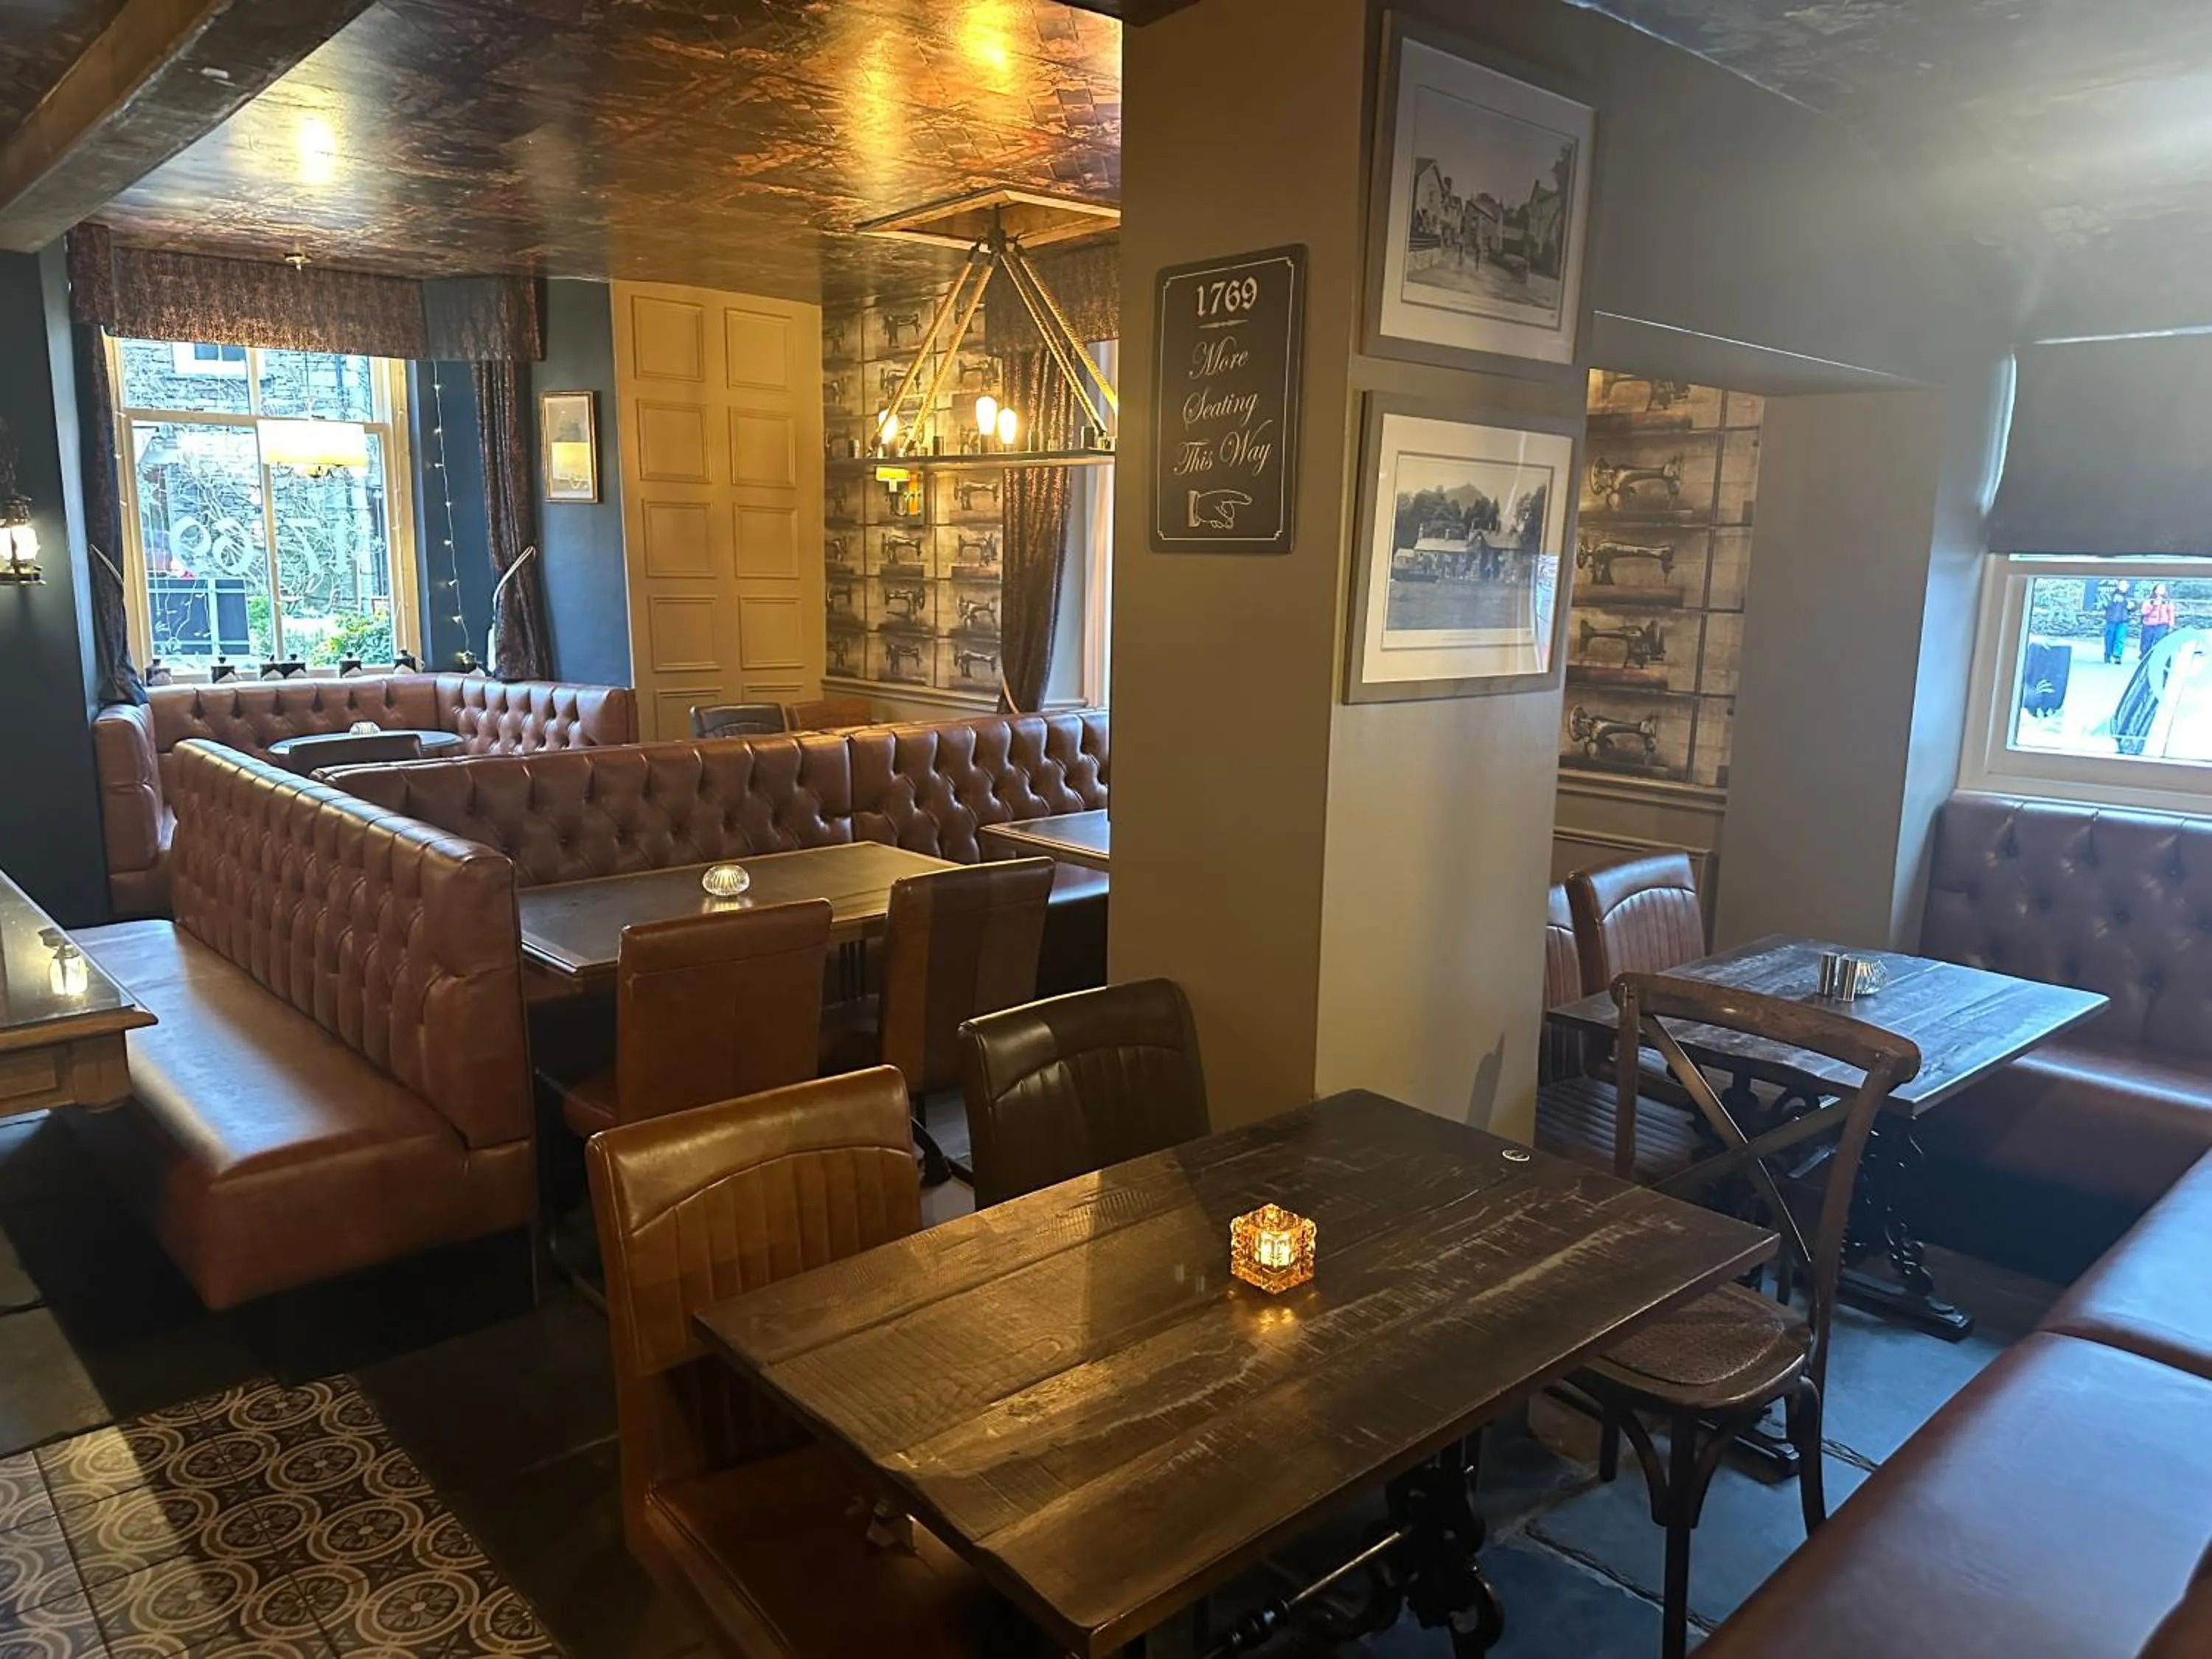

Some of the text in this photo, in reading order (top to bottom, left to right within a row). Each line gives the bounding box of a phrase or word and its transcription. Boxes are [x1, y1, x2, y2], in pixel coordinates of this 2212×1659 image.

[1197, 277, 1258, 317] 1769
[1189, 335, 1249, 380] More
[1182, 386, 1259, 431] Seating
[1173, 419, 1273, 477] This Way
